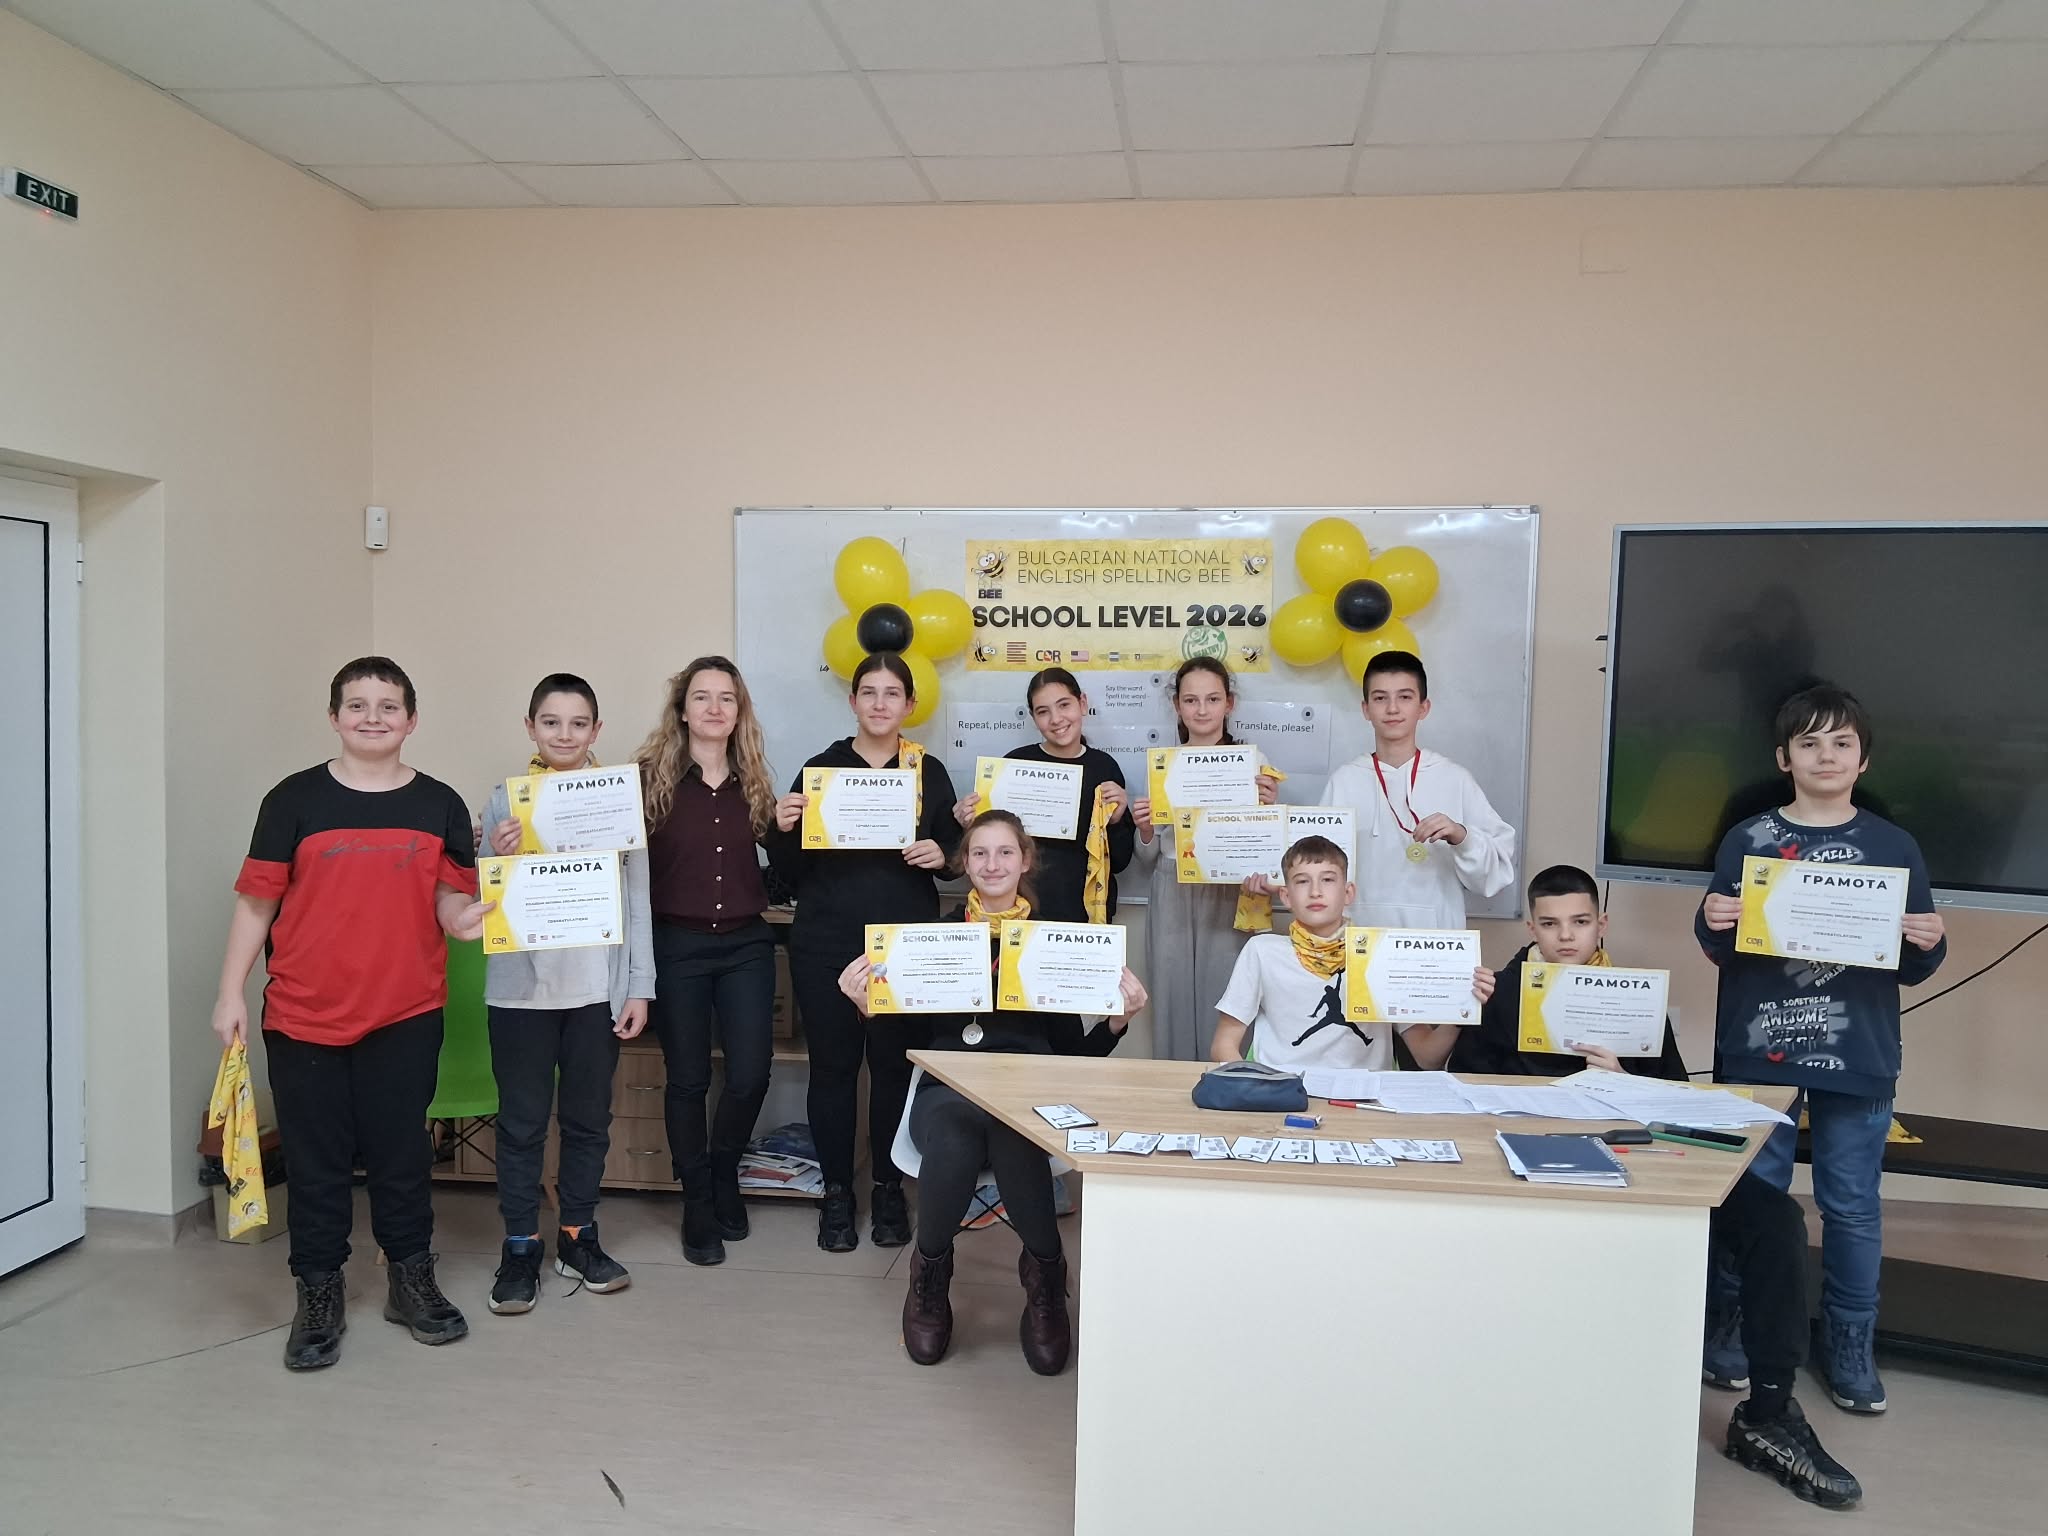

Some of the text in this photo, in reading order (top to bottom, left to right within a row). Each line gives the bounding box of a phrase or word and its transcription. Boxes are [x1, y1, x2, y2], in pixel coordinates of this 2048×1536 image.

[27, 180, 68, 211] EXIT
[1017, 549, 1230, 565] BULGARIAN NATIONAL
[1017, 568, 1231, 584] ENGLISH SPELLING BEE
[978, 588, 1003, 599] BEE
[972, 604, 1267, 628] SCHOOL LEVEL 2026
[958, 720, 1025, 731] Repeat, please!
[1234, 720, 1315, 733] Translate, please!
[1187, 754, 1245, 764] ГРАМОТА
[1015, 769, 1070, 781] ГРАМОТА
[557, 776, 625, 793] ГРАМОТА
[845, 778, 904, 787] ГРАМОТА
[1207, 814, 1279, 823] SCHOOL WINNER
[1289, 816, 1343, 825] РАМОТА
[530, 862, 603, 875] ГРАМОТА
[1803, 874, 1888, 890] ГРАМОТА
[942, 934, 980, 942] WINNER
[1047, 933, 1112, 945] ГРАМОТА
[1395, 940, 1465, 950] ГРАМОТА
[1575, 976, 1651, 990] ГРАМОТА
[1782, 995, 1831, 1007] SOMETHING
[1761, 1006, 1828, 1030] AWESOME
[1073, 1139, 1097, 1152] 10
[1281, 1154, 1308, 1164] 5
